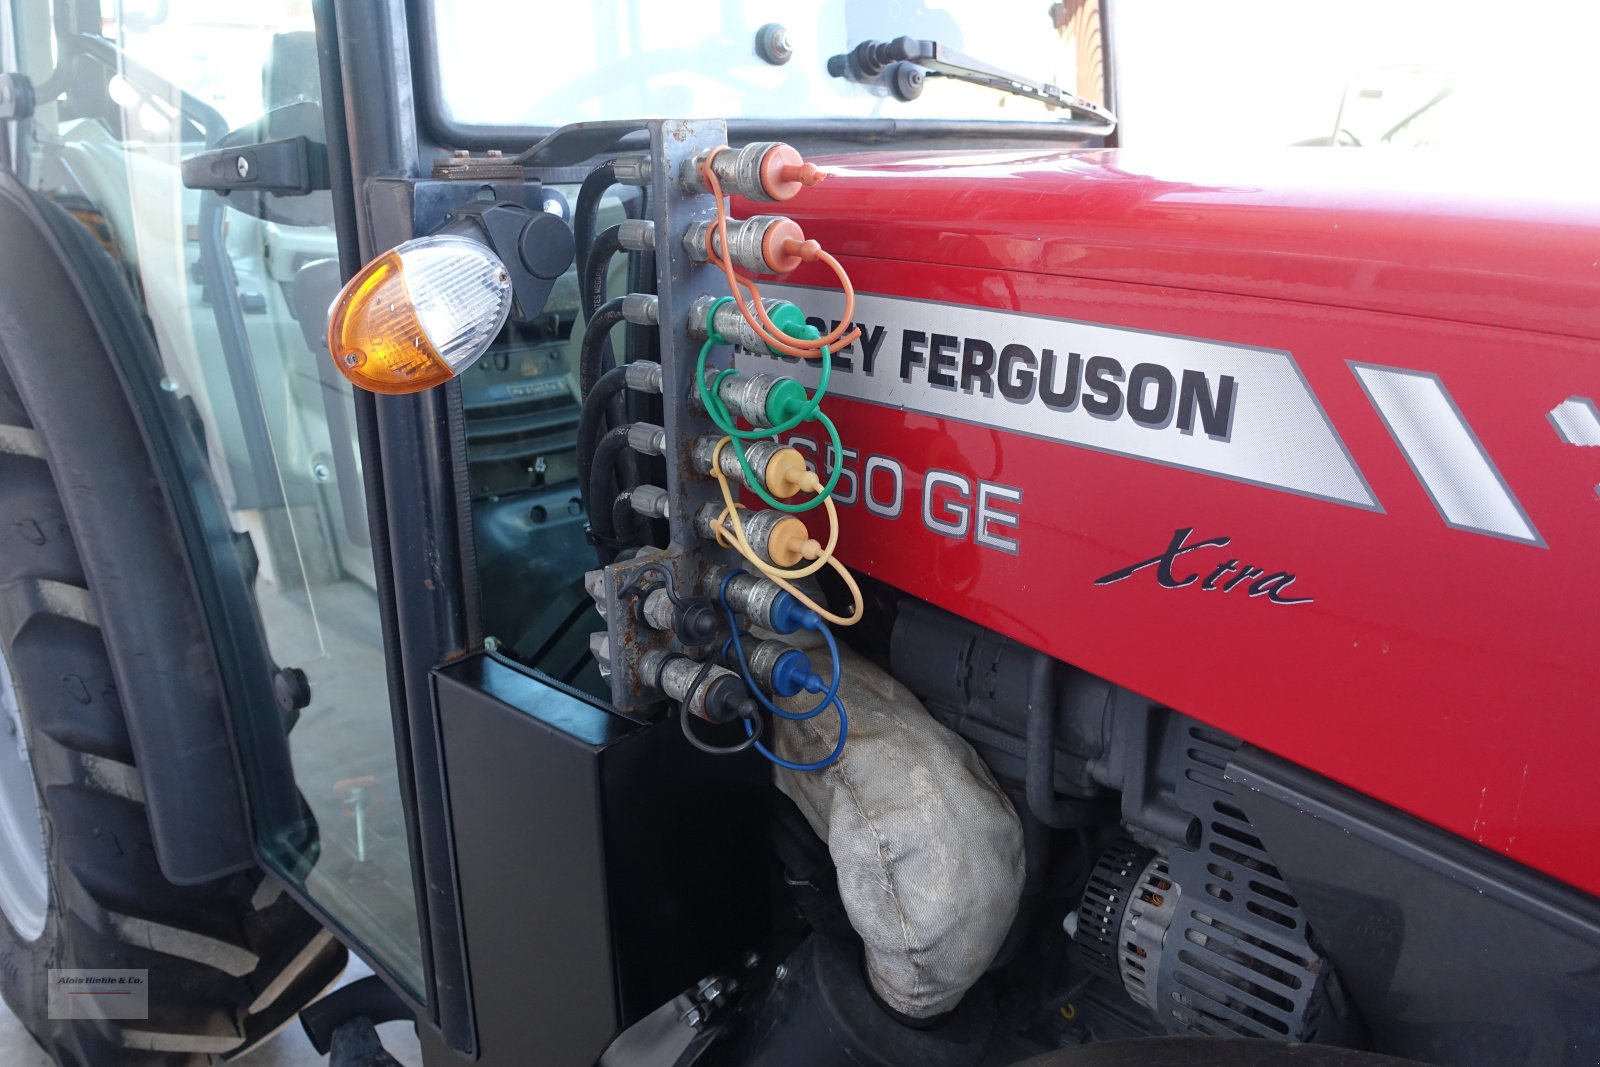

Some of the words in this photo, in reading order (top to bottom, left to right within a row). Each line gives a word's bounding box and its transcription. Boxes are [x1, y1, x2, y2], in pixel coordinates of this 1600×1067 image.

[900, 329, 1238, 442] FERGUSON
[922, 468, 1023, 556] GE
[1094, 527, 1314, 604] Xtra
